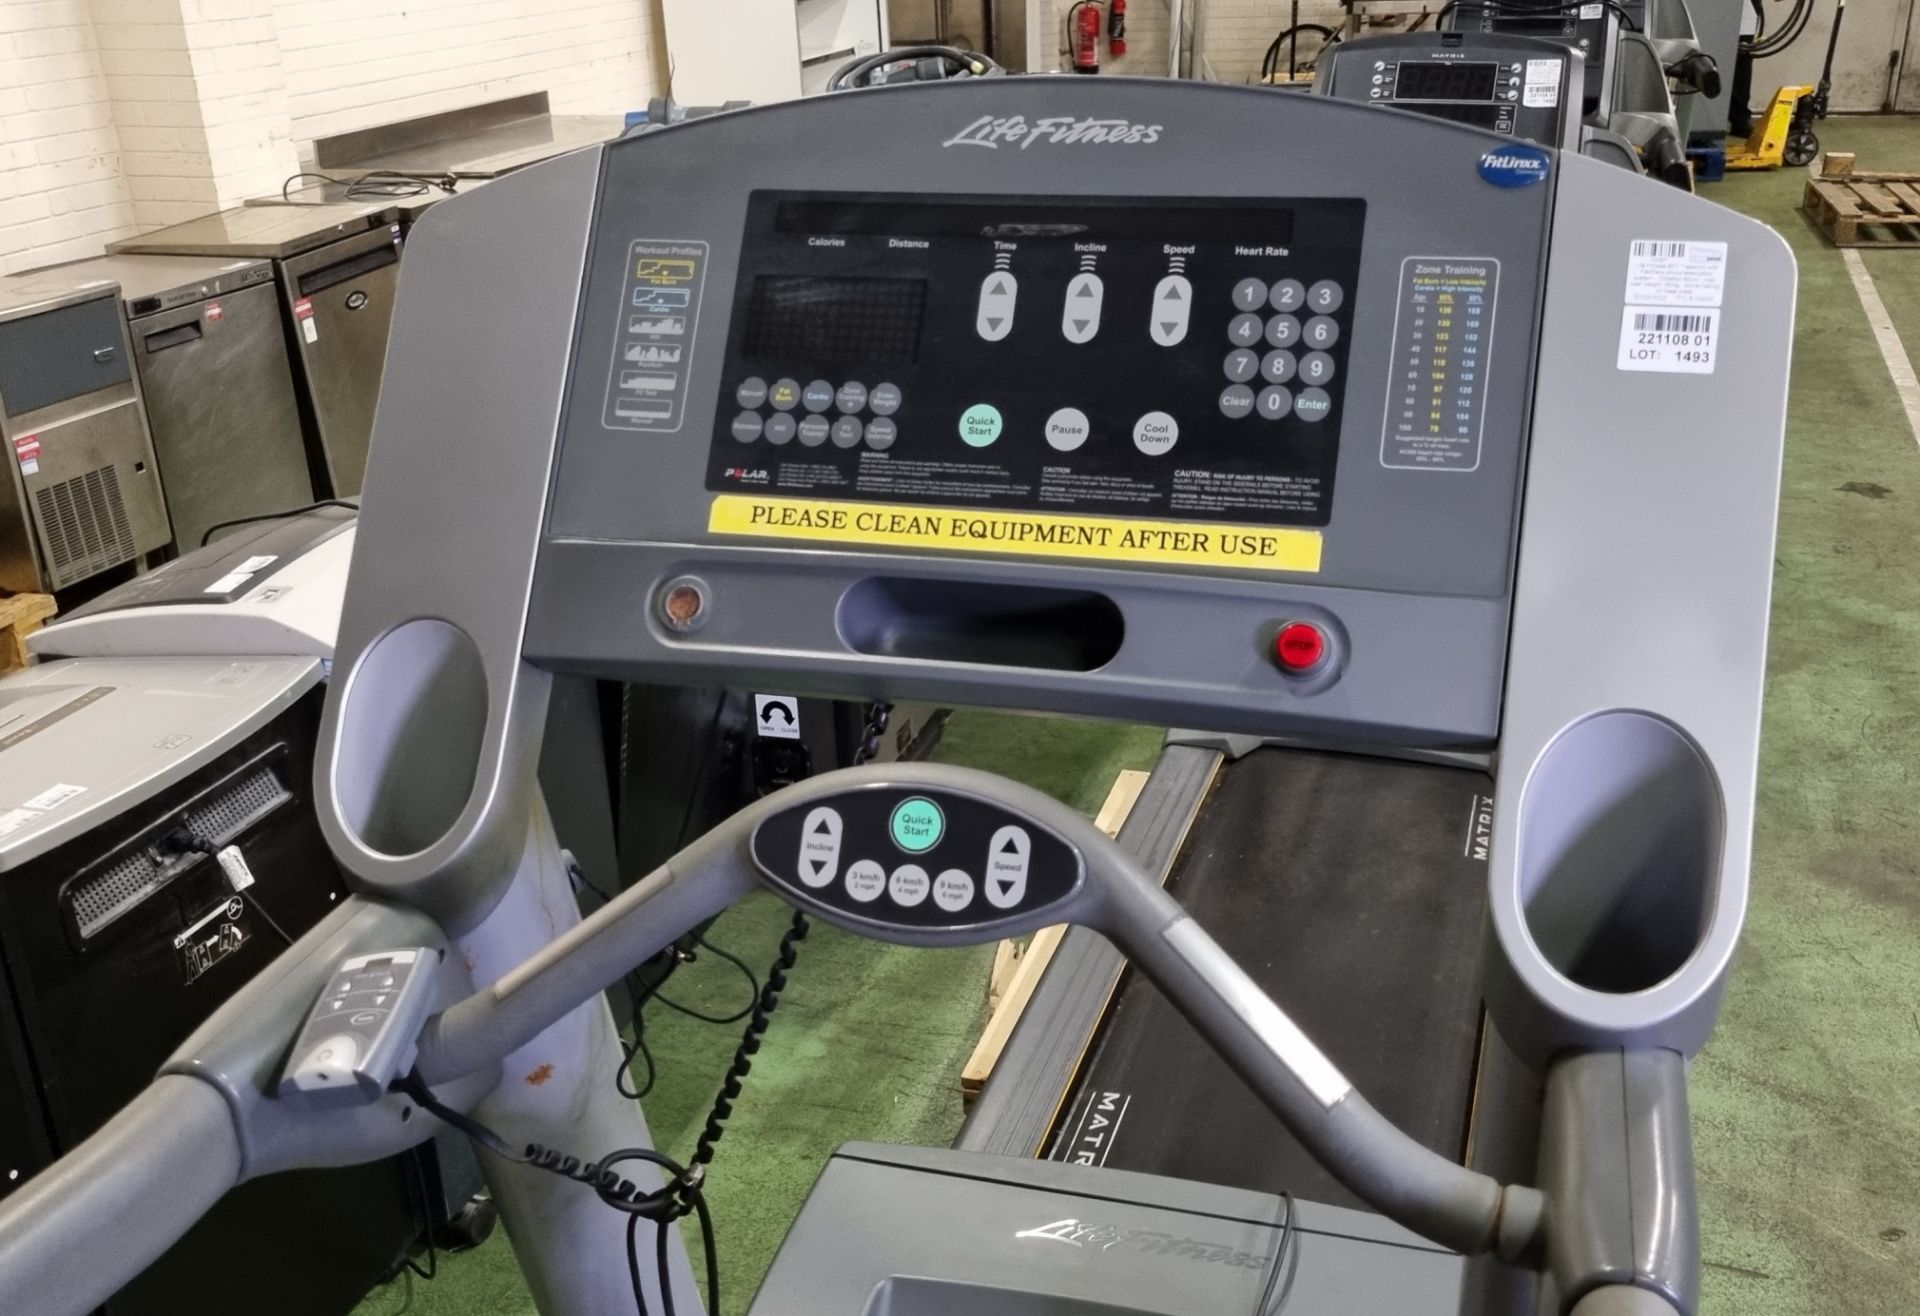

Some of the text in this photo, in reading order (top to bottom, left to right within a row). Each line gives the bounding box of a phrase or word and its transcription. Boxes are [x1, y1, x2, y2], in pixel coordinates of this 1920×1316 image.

[943, 115, 1163, 150] Life Fitness
[1483, 154, 1541, 169] FitLinxx
[808, 237, 845, 247] Calories
[889, 239, 929, 248] Distance
[994, 241, 1017, 250] Time
[1075, 242, 1106, 252] Incline
[635, 246, 702, 256] Workout Profiles
[1163, 244, 1195, 254] Speed
[1235, 246, 1289, 256] Heart Rate
[1415, 265, 1486, 277] Zone Training
[1244, 286, 1254, 302] 1
[1281, 287, 1294, 303] 2
[1319, 288, 1331, 305] 3
[1238, 321, 1251, 338] 4
[1277, 322, 1290, 339] 5
[1314, 324, 1327, 340] 6
[1638, 333, 1710, 346] 221108 01
[1629, 349, 1710, 363] LOT: 1493
[1236, 357, 1248, 374] 7
[1272, 358, 1284, 375] 8
[1310, 360, 1323, 377] 9
[1222, 396, 1250, 406] Clear
[1268, 393, 1280, 410] 0
[1297, 399, 1328, 410] Enter
[967, 416, 995, 426] Quick
[968, 427, 992, 436] Start
[1052, 425, 1083, 435] Pause
[1144, 424, 1169, 433] Cool
[1140, 434, 1170, 444] Down
[724, 468, 768, 478] POLAR
[751, 505, 1278, 557] PLEASE CLEAN EQUIPMENT AFTER USE
[902, 813, 934, 825] Quick
[904, 825, 929, 836] Start
[1473, 796, 1493, 860] MATRIX
[806, 840, 834, 852] Incline
[994, 861, 1022, 873] Speed
[859, 872, 880, 881] km/h
[902, 877, 924, 886] km/h
[947, 882, 968, 891] km/h
